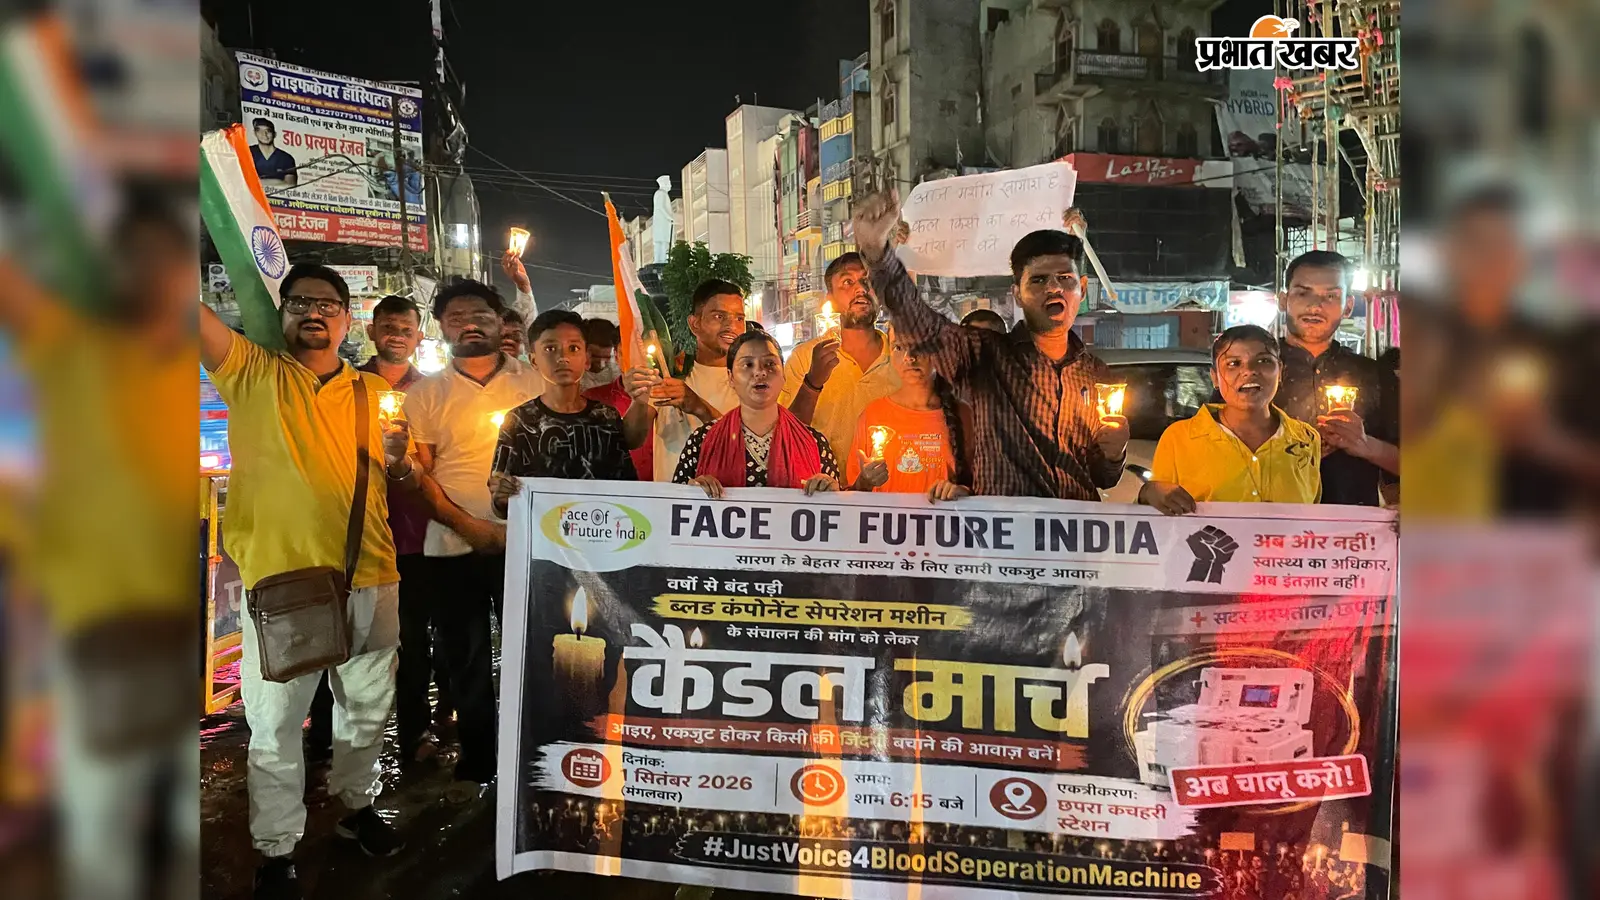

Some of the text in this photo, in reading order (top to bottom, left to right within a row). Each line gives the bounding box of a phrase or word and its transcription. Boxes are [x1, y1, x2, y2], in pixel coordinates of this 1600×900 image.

[1227, 99, 1275, 116] HYBRID
[339, 133, 364, 157] रंजन
[298, 210, 328, 231] रंजन
[559, 506, 610, 526] Face Of
[570, 520, 646, 540] Future India
[671, 504, 1159, 555] FACE OF FUTURE INDIA
[1254, 530, 1376, 552] अब और नहीं!
[736, 553, 1099, 580] सारण के बेहतर स्वास्थ्य के लिए हमारी एकजुट आवाज़
[1253, 556, 1391, 572] स्वास्थ्य का अधिकार,
[703, 577, 719, 592] से
[724, 579, 749, 594] बंद
[754, 579, 784, 597] पड़ी
[1254, 573, 1366, 589] अब इंतज़ार नहीं!
[669, 598, 947, 626] ब्लड कंपोनेंट सेपरेशन मशीन
[726, 625, 920, 646] के संचालन की मांग को लेकर
[894, 658, 1110, 738] मार्च
[611, 721, 656, 739] आइए,
[662, 726, 715, 744] एकजुट
[720, 725, 762, 743] होकर
[767, 728, 808, 745] किसी
[813, 729, 834, 746] की
[893, 735, 935, 752] बचाने
[941, 737, 964, 753] की
[969, 741, 1022, 760] आवाज़
[1028, 745, 1061, 761] बनें!
[621, 752, 665, 769] दिनांक:
[634, 768, 691, 787] सितंबर
[697, 775, 753, 791] 2026
[1185, 761, 1355, 799] अब चालू करो!
[621, 785, 683, 803] (मंगलवार)
[854, 791, 964, 811] शाम 6:15 बजे
[1057, 783, 1138, 800] एकत्रीकरण:
[1057, 800, 1167, 821] छपरा कचहरी
[1057, 815, 1110, 833] स्टेशन
[703, 836, 1202, 889] #JustVoice4BloodSeperationMachine
